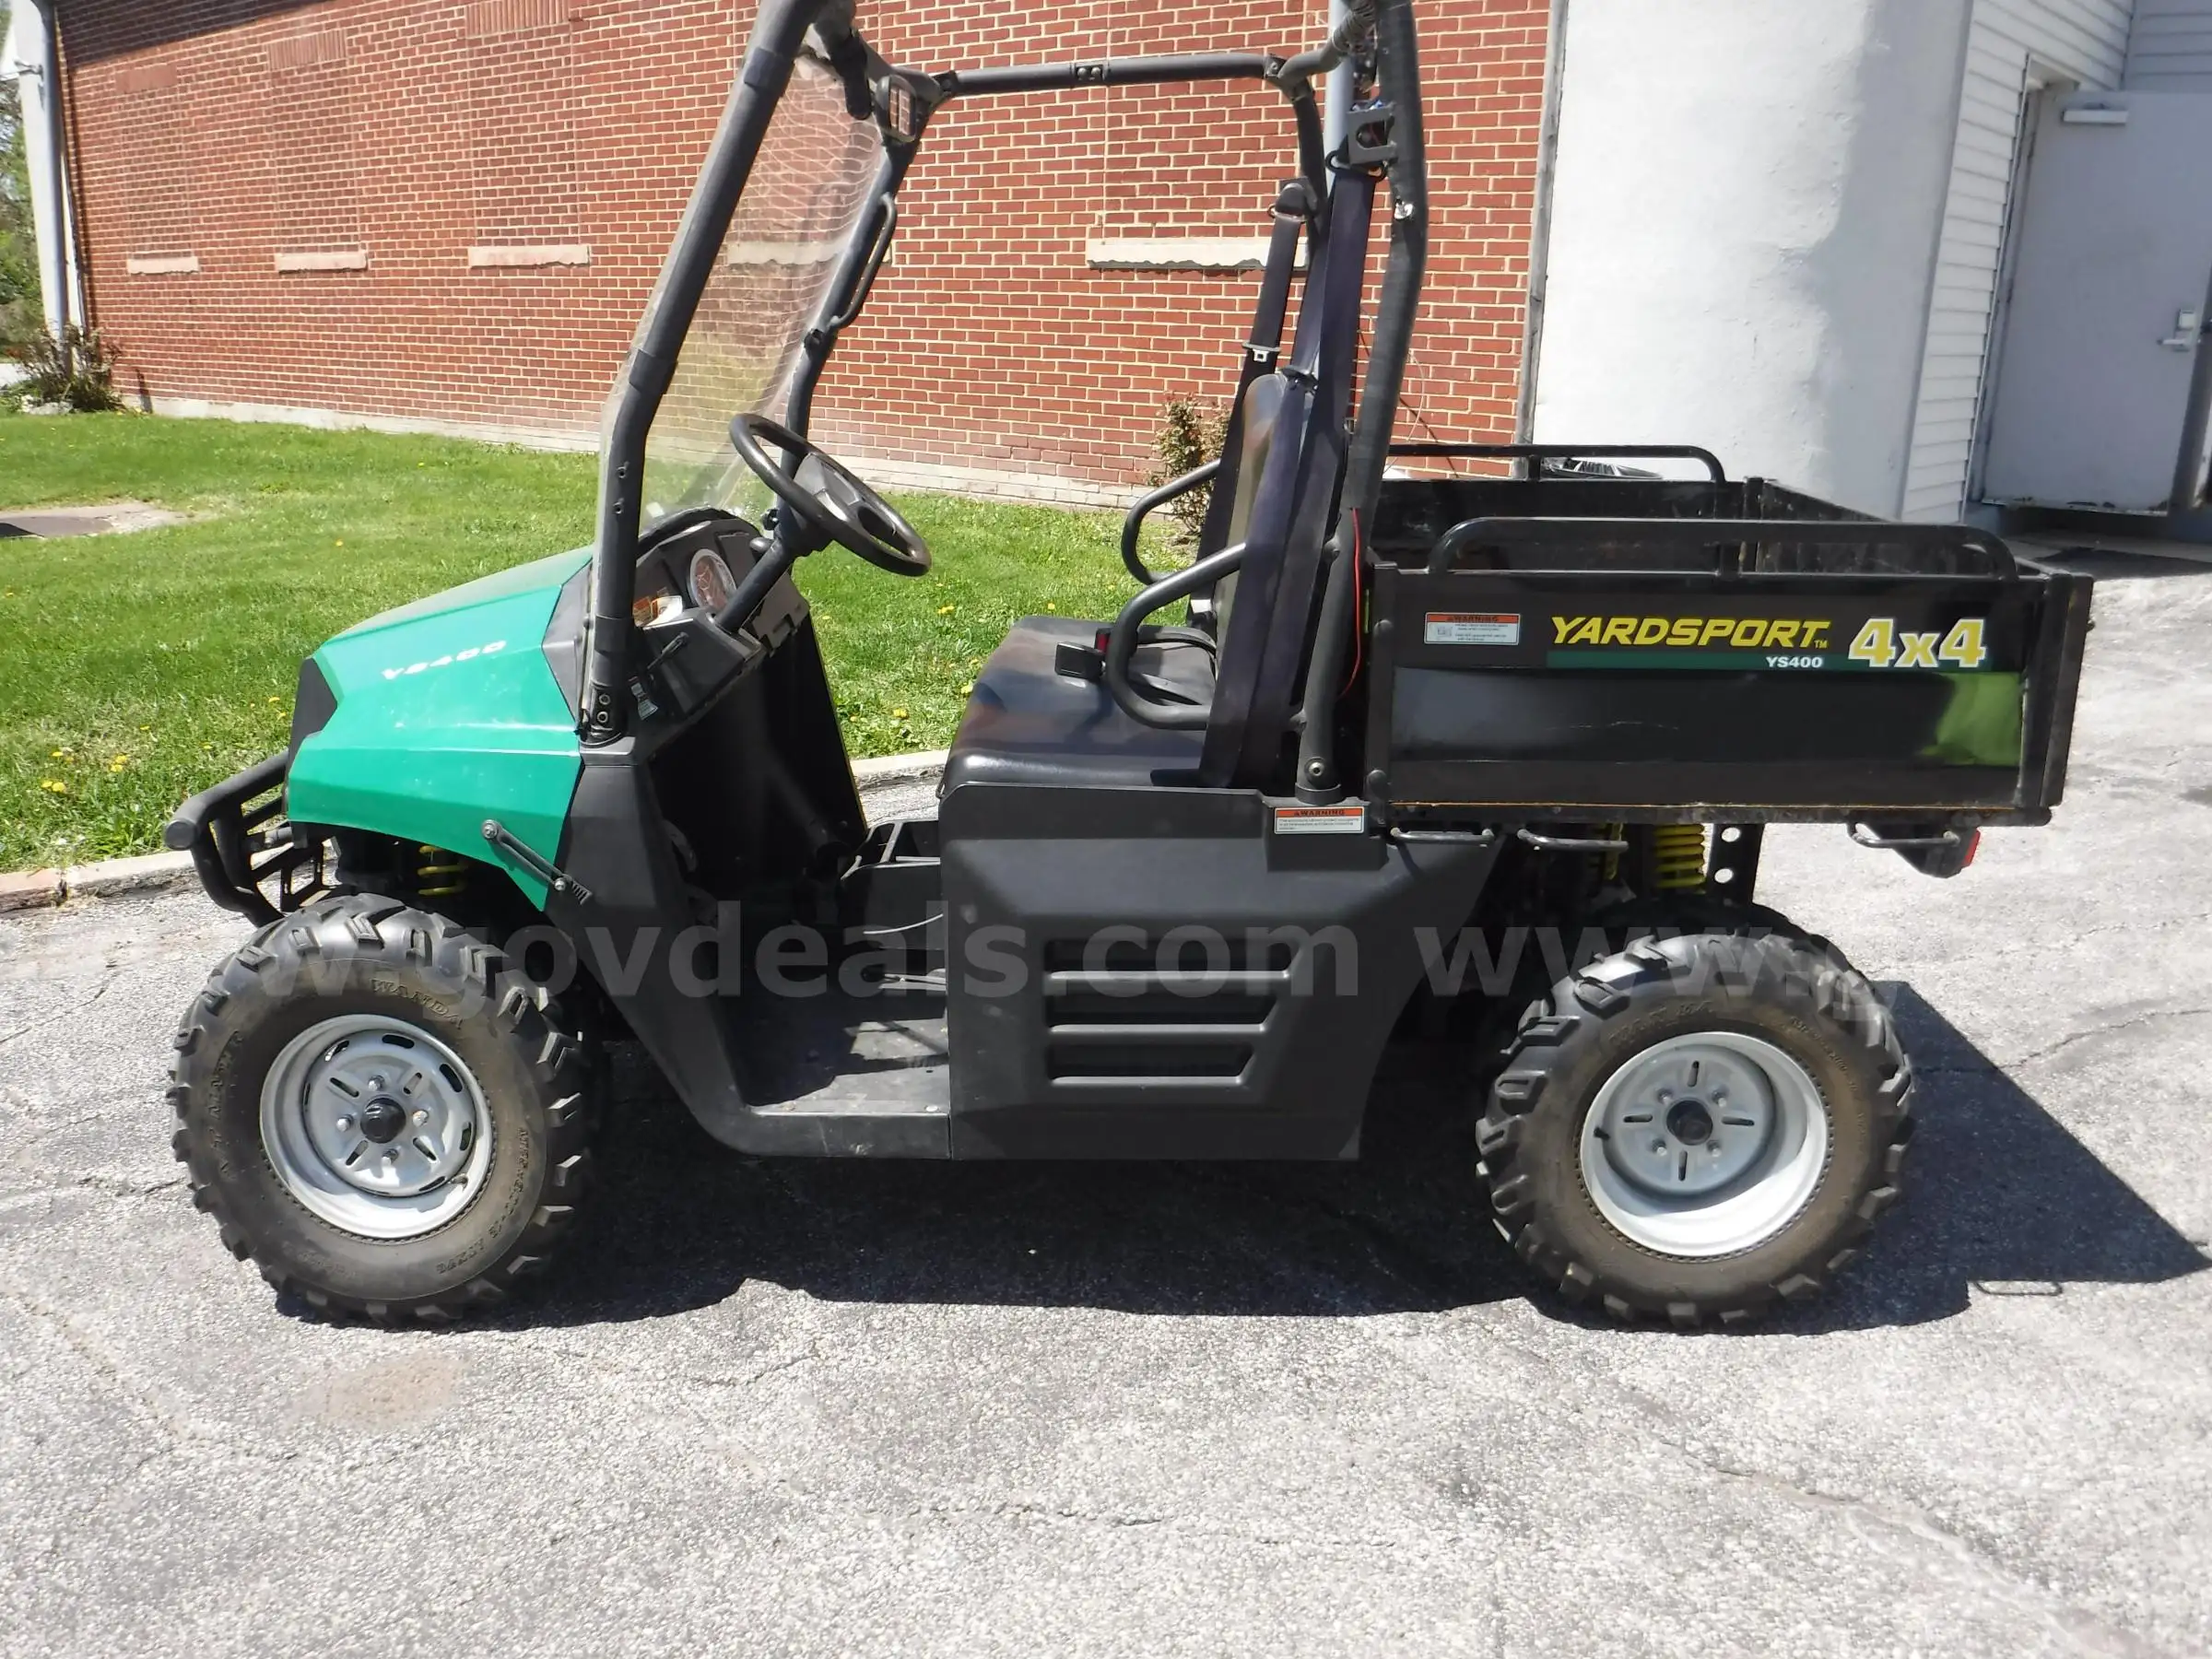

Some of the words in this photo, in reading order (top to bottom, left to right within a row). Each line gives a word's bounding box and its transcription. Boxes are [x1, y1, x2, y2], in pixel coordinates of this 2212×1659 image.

[1453, 615, 1499, 623] WARNING
[1551, 617, 1830, 648] YARDSPORT
[1848, 618, 1987, 667] 4x4
[1766, 656, 1823, 668] YS400
[370, 977, 464, 1030] WANDA
